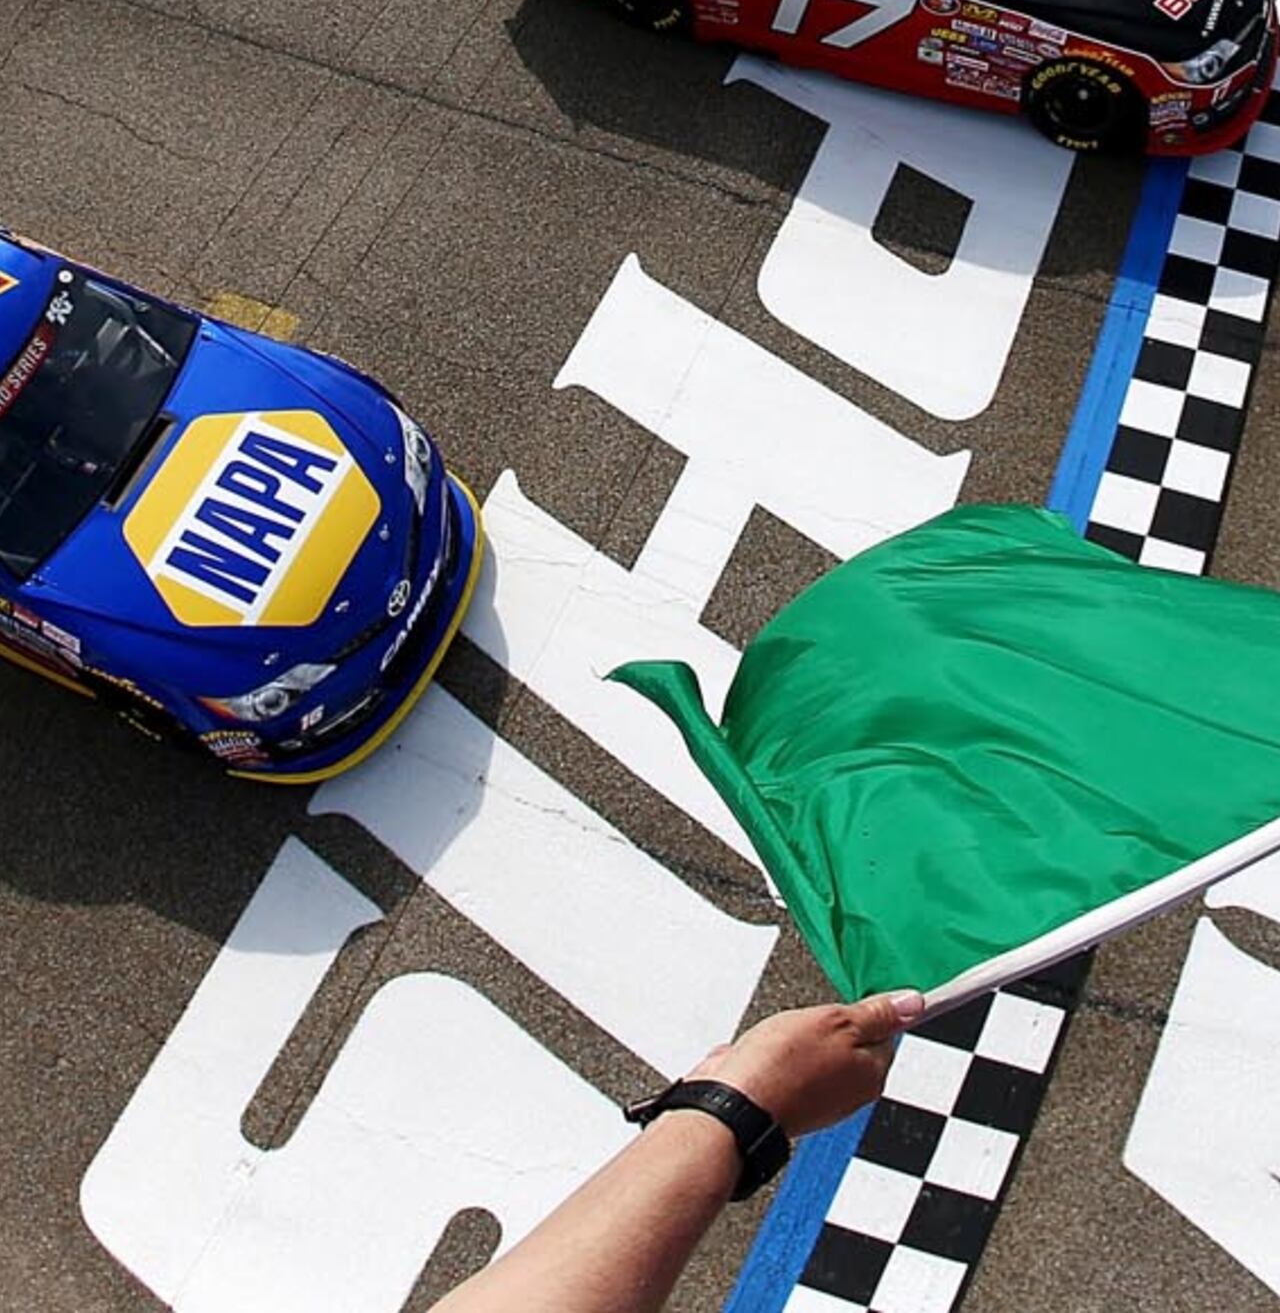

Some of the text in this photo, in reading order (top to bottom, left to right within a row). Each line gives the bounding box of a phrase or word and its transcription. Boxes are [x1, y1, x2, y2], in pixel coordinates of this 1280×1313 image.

[1031, 63, 1122, 95] GOODYEAR
[8, 337, 48, 390] SERIES
[165, 431, 338, 605] NAPA
[379, 558, 442, 672] CAMRY
[301, 704, 325, 731] 16
